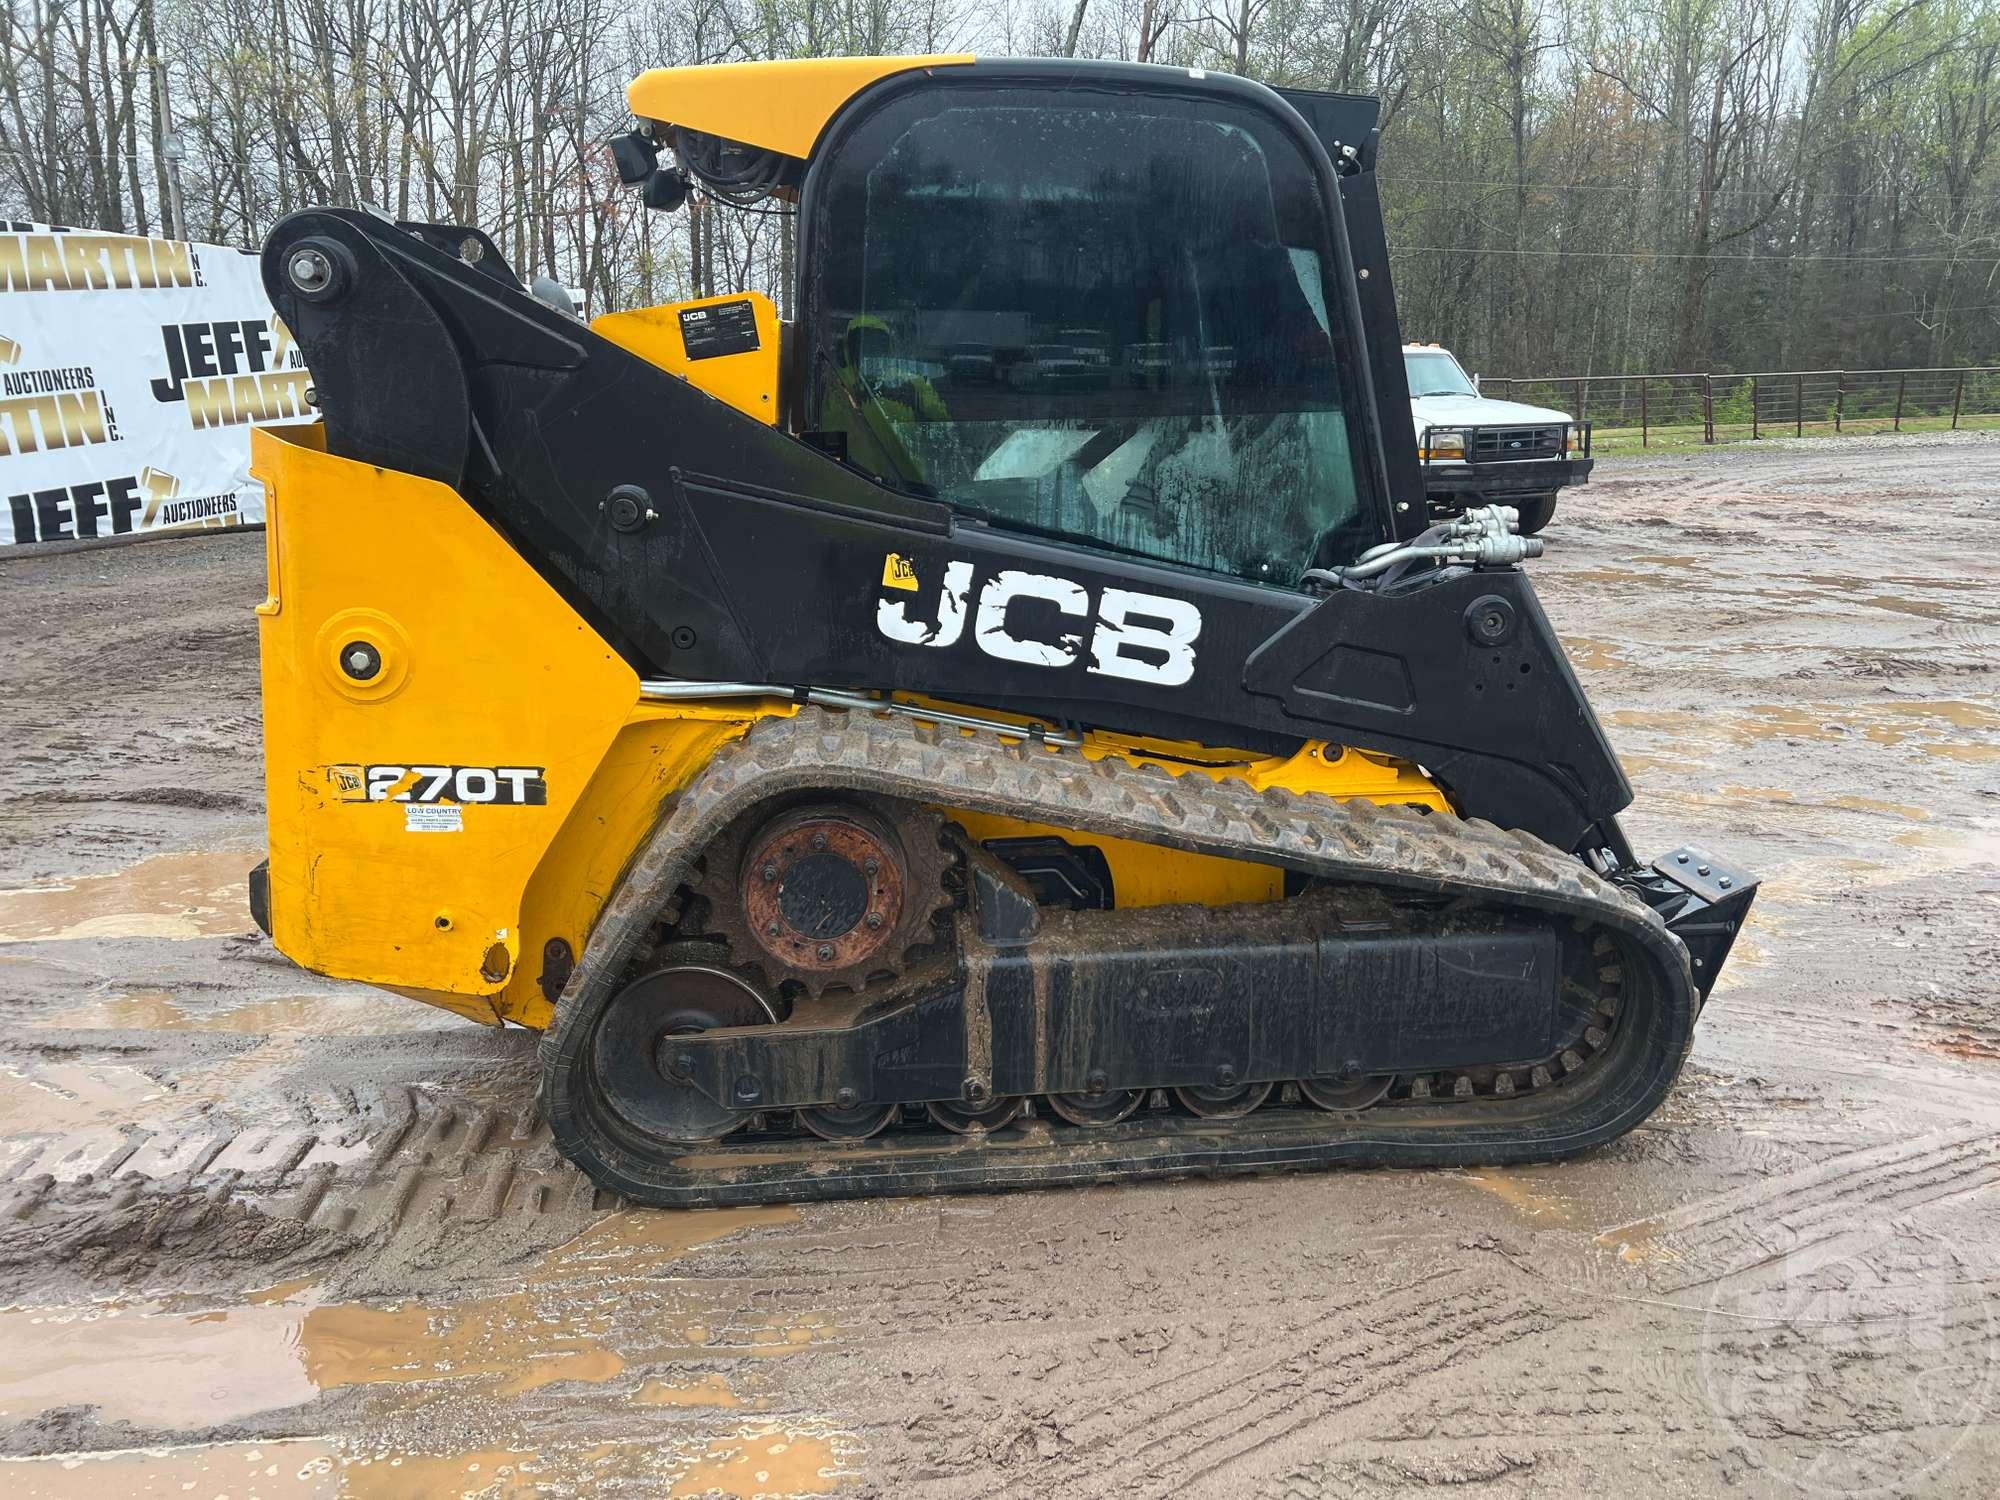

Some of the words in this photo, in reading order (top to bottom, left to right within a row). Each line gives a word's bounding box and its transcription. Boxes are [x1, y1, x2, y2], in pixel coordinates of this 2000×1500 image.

[682, 311, 707, 322] JCB
[150, 320, 271, 403] JEFF
[3, 366, 95, 396] AUCTIONEERS
[183, 370, 321, 431] MART
[163, 492, 237, 525] AUCTIONEERS
[876, 560, 1203, 686] JCB
[339, 773, 360, 792] JCB
[367, 766, 539, 802] 270T
[425, 807, 462, 815] COUNTRY
